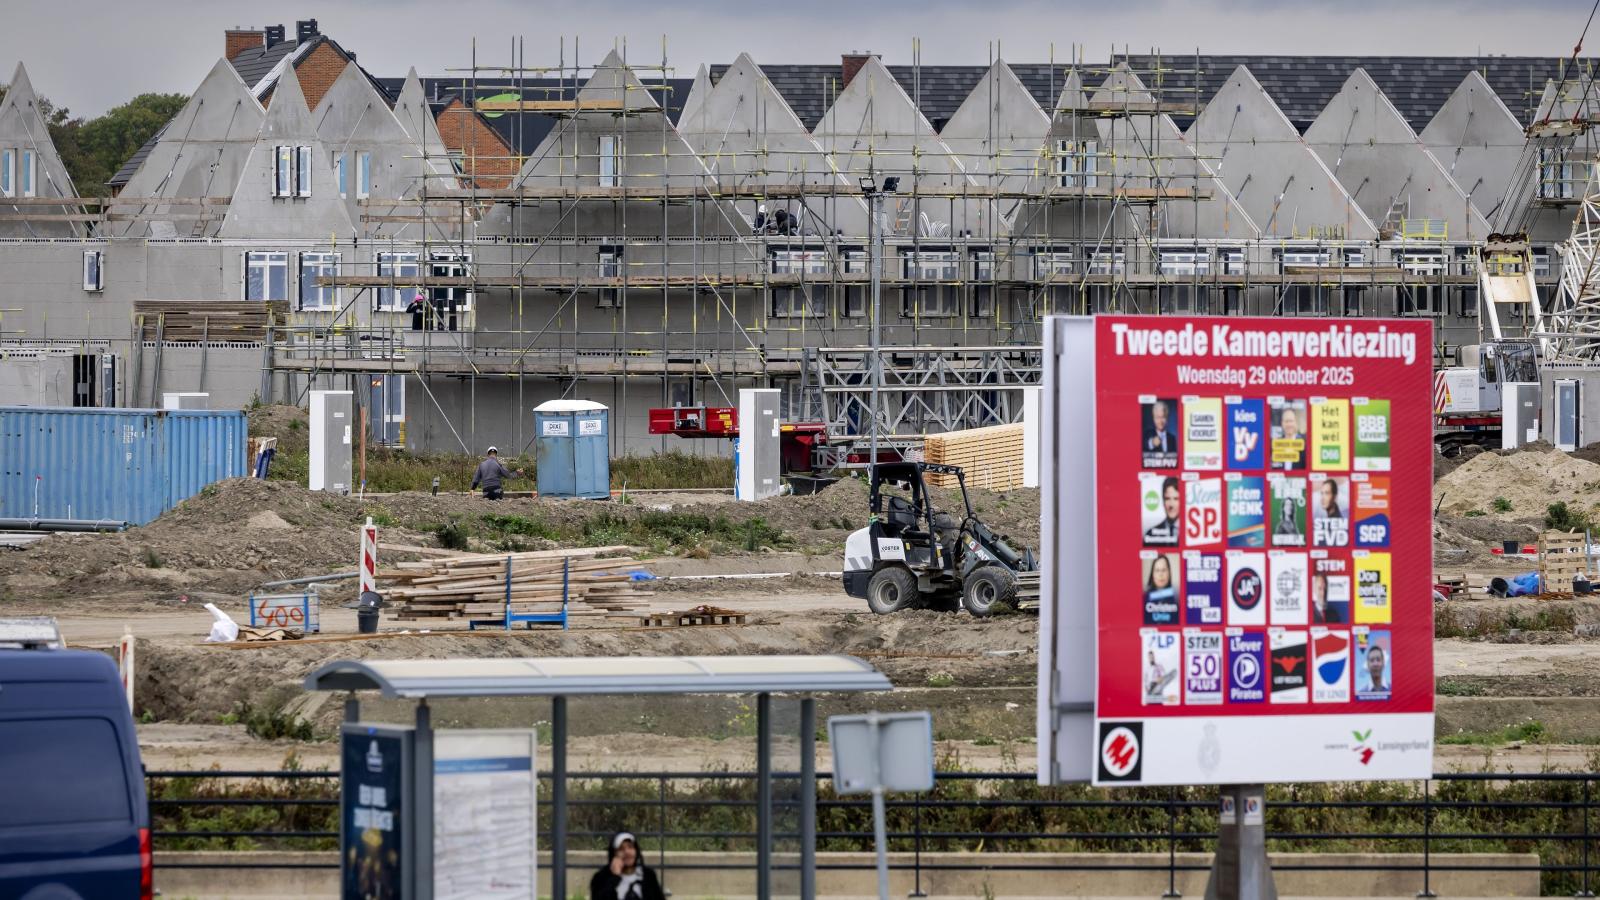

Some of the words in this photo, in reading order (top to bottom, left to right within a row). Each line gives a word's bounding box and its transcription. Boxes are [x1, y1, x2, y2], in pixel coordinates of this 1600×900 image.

[1111, 323, 1208, 356] Tweede
[1212, 325, 1416, 365] Kamerverkiezing
[1177, 365, 1246, 388] Woensdag
[1248, 366, 1266, 384] 29
[1268, 366, 1319, 385] oktober
[1321, 366, 1354, 385] 2025
[1321, 407, 1339, 416] Het
[1321, 419, 1339, 429] kan
[1232, 486, 1261, 500] stem
[1231, 501, 1263, 516] DENK
[1314, 518, 1347, 530] STEM
[1313, 530, 1348, 547] FVD
[1359, 525, 1386, 543] SGP
[1316, 560, 1346, 572] STEM
[258, 600, 304, 627] 400
[1188, 637, 1219, 649] STEM
[1230, 636, 1263, 652] Liever
[1192, 656, 1216, 676] 50
[1190, 679, 1217, 691] PLUS
[1230, 688, 1263, 700] Piraten
